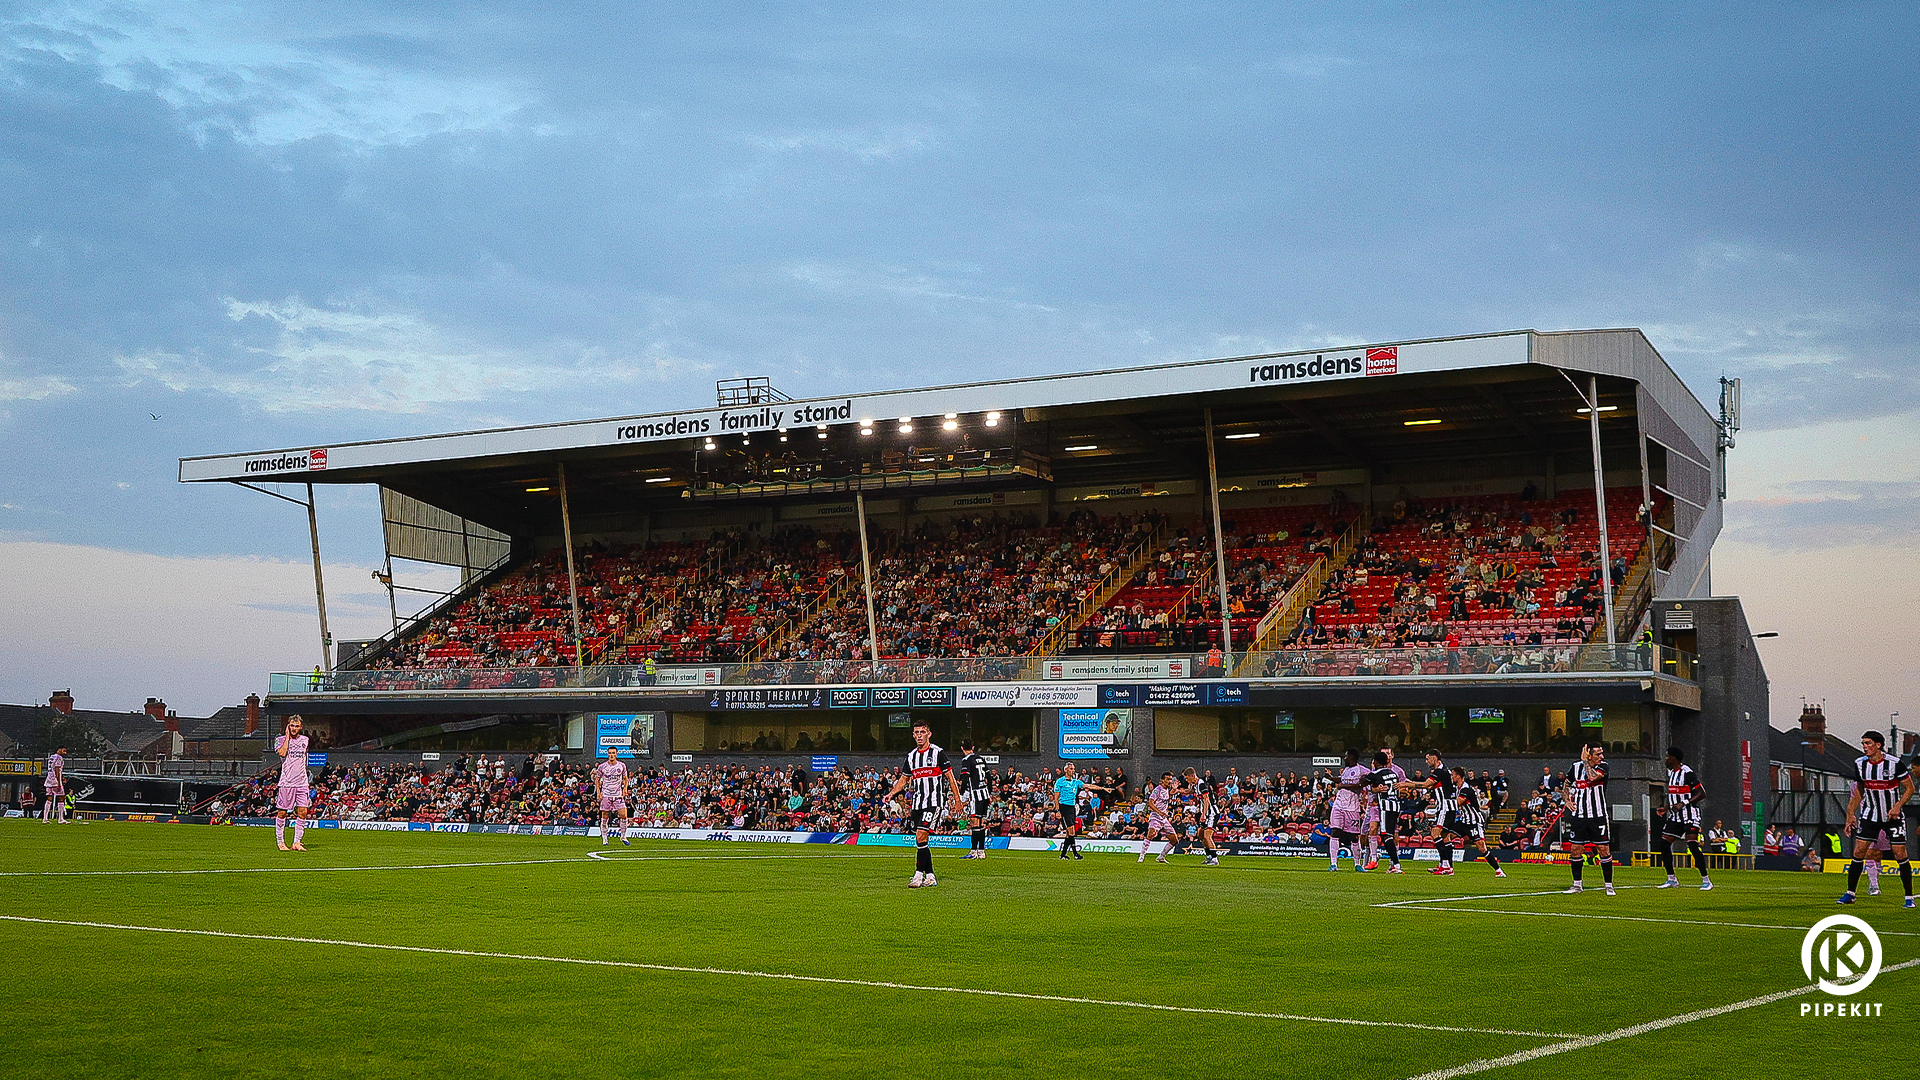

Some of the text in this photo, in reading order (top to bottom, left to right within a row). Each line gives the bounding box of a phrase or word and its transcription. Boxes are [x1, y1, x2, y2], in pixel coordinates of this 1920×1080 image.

[1367, 358, 1396, 368] home
[1250, 355, 1362, 382] ramsdens
[617, 400, 851, 439] ramsdens family stand
[244, 453, 308, 472] ramsdens
[953, 496, 992, 506] ramsdens
[818, 505, 853, 515] ramsdens
[1072, 664, 1108, 674] ramsdens
[1111, 664, 1136, 675] family
[1137, 665, 1159, 673] stand
[660, 673, 679, 682] family
[680, 673, 697, 681] stand
[725, 690, 810, 701] SPORTS THERAPY
[833, 692, 863, 700] ROOST
[875, 691, 905, 699] ROOST
[917, 690, 948, 698] ROOST
[961, 690, 1014, 700] HANDTRANS
[921, 811, 933, 822] 18
[1470, 828, 1479, 837] 16
[1598, 824, 1606, 836] 7
[1889, 826, 1906, 838] 24
[630, 831, 681, 840] INSURANCE
[706, 831, 792, 844] attis INSURANCE
